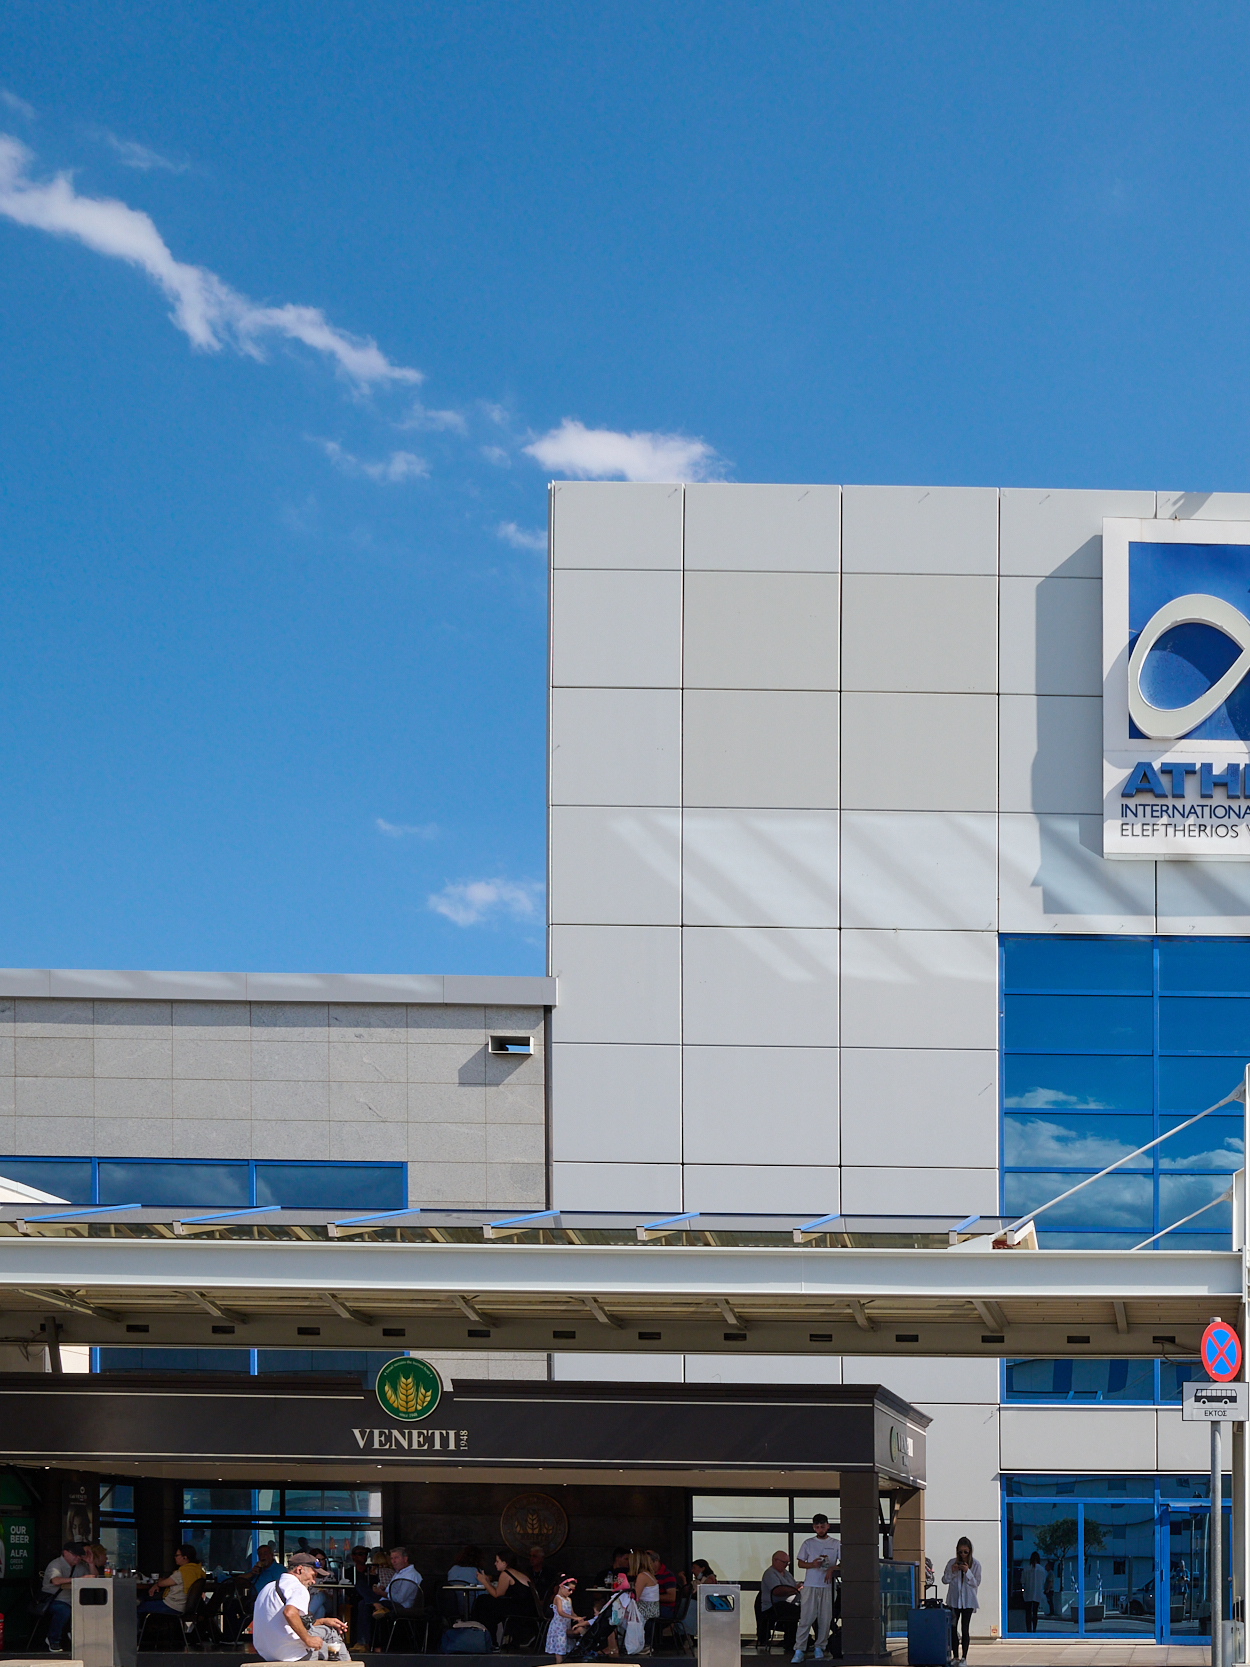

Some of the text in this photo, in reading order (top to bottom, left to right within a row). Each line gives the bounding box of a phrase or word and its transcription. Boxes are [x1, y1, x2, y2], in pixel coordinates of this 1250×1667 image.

[1120, 823, 1239, 838] ELEFTHERIOS
[351, 1428, 468, 1450] VENETI 1948
[10, 1525, 27, 1535] OUR
[10, 1534, 30, 1544] BEER
[10, 1549, 28, 1558] ALFA
